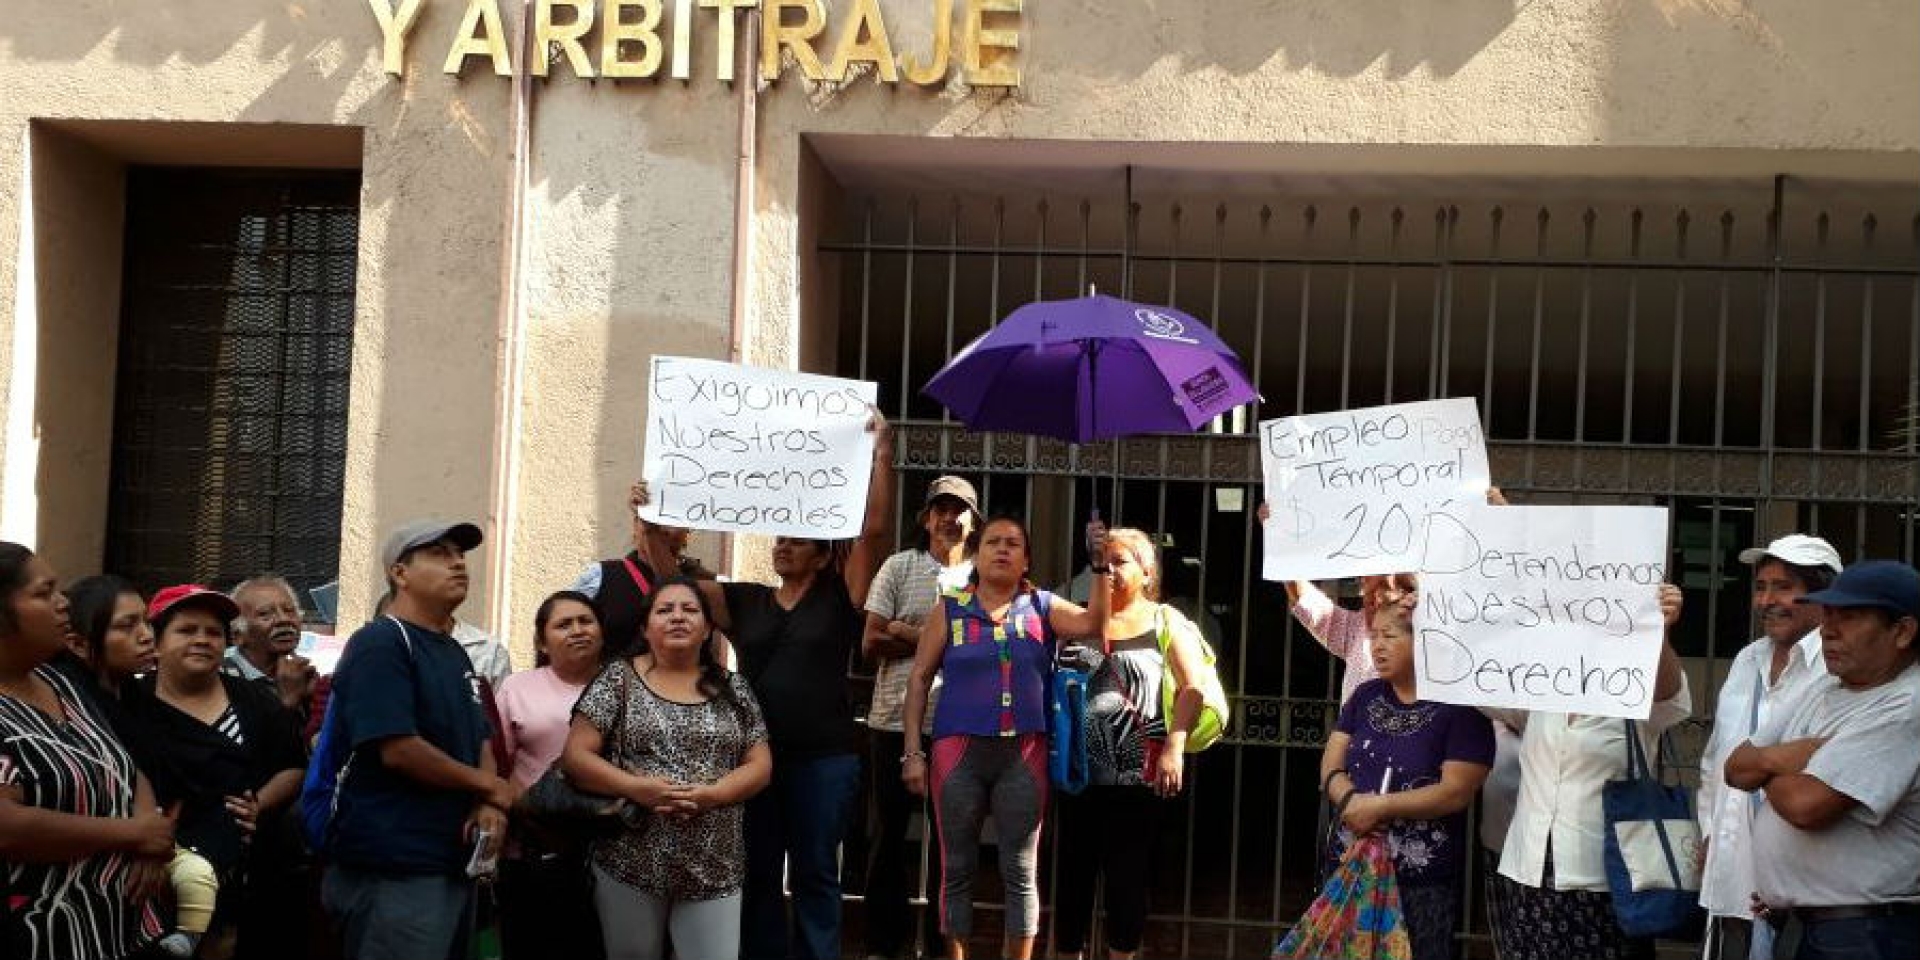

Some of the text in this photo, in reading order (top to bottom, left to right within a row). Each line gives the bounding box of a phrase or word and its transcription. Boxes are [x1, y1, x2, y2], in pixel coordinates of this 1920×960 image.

[371, 0, 1022, 88] Y ARBITRAJE
[653, 359, 868, 417] Exiguimos
[658, 412, 829, 453] Nuestros
[1266, 413, 1410, 459] Empleo
[660, 452, 848, 491] Derechos
[1294, 447, 1464, 494] Temporal
[658, 489, 848, 530] Laborales
[1420, 511, 1667, 585] Defendemos
[1426, 586, 1634, 638] Nuestros
[1420, 628, 1647, 708] Derechos
